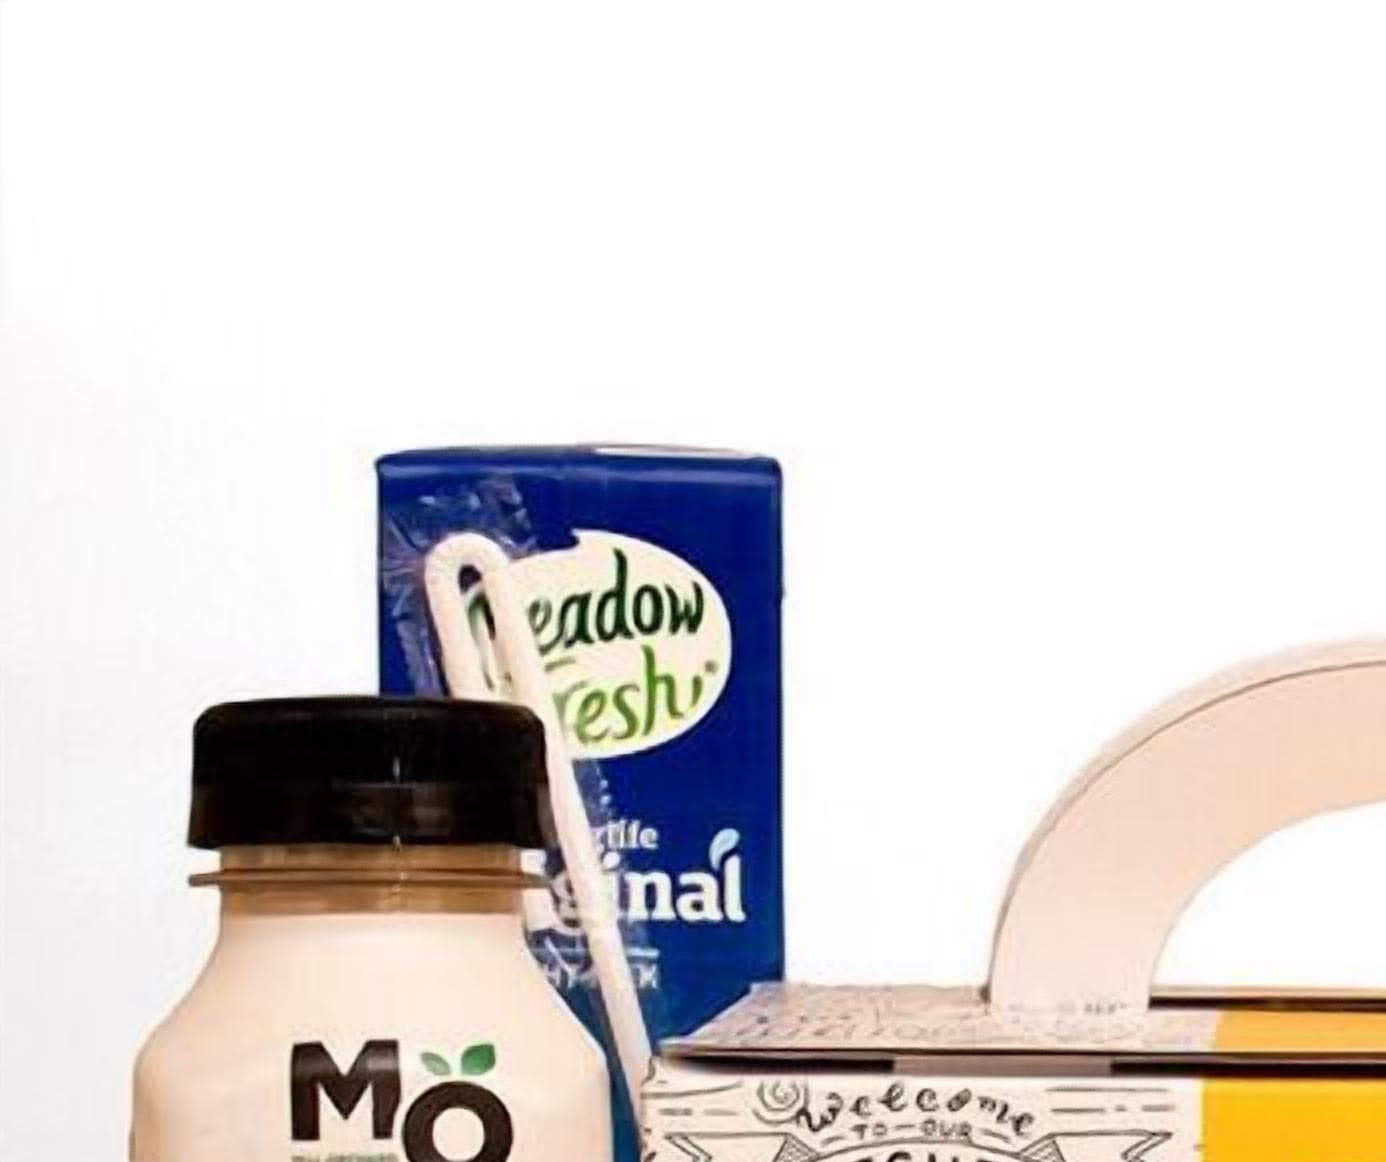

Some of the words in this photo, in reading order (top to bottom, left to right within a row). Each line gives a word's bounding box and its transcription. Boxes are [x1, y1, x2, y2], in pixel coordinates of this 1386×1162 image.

[545, 645, 686, 745] resh
[850, 1124, 888, 1139] TO
[920, 1118, 973, 1138] OUR
